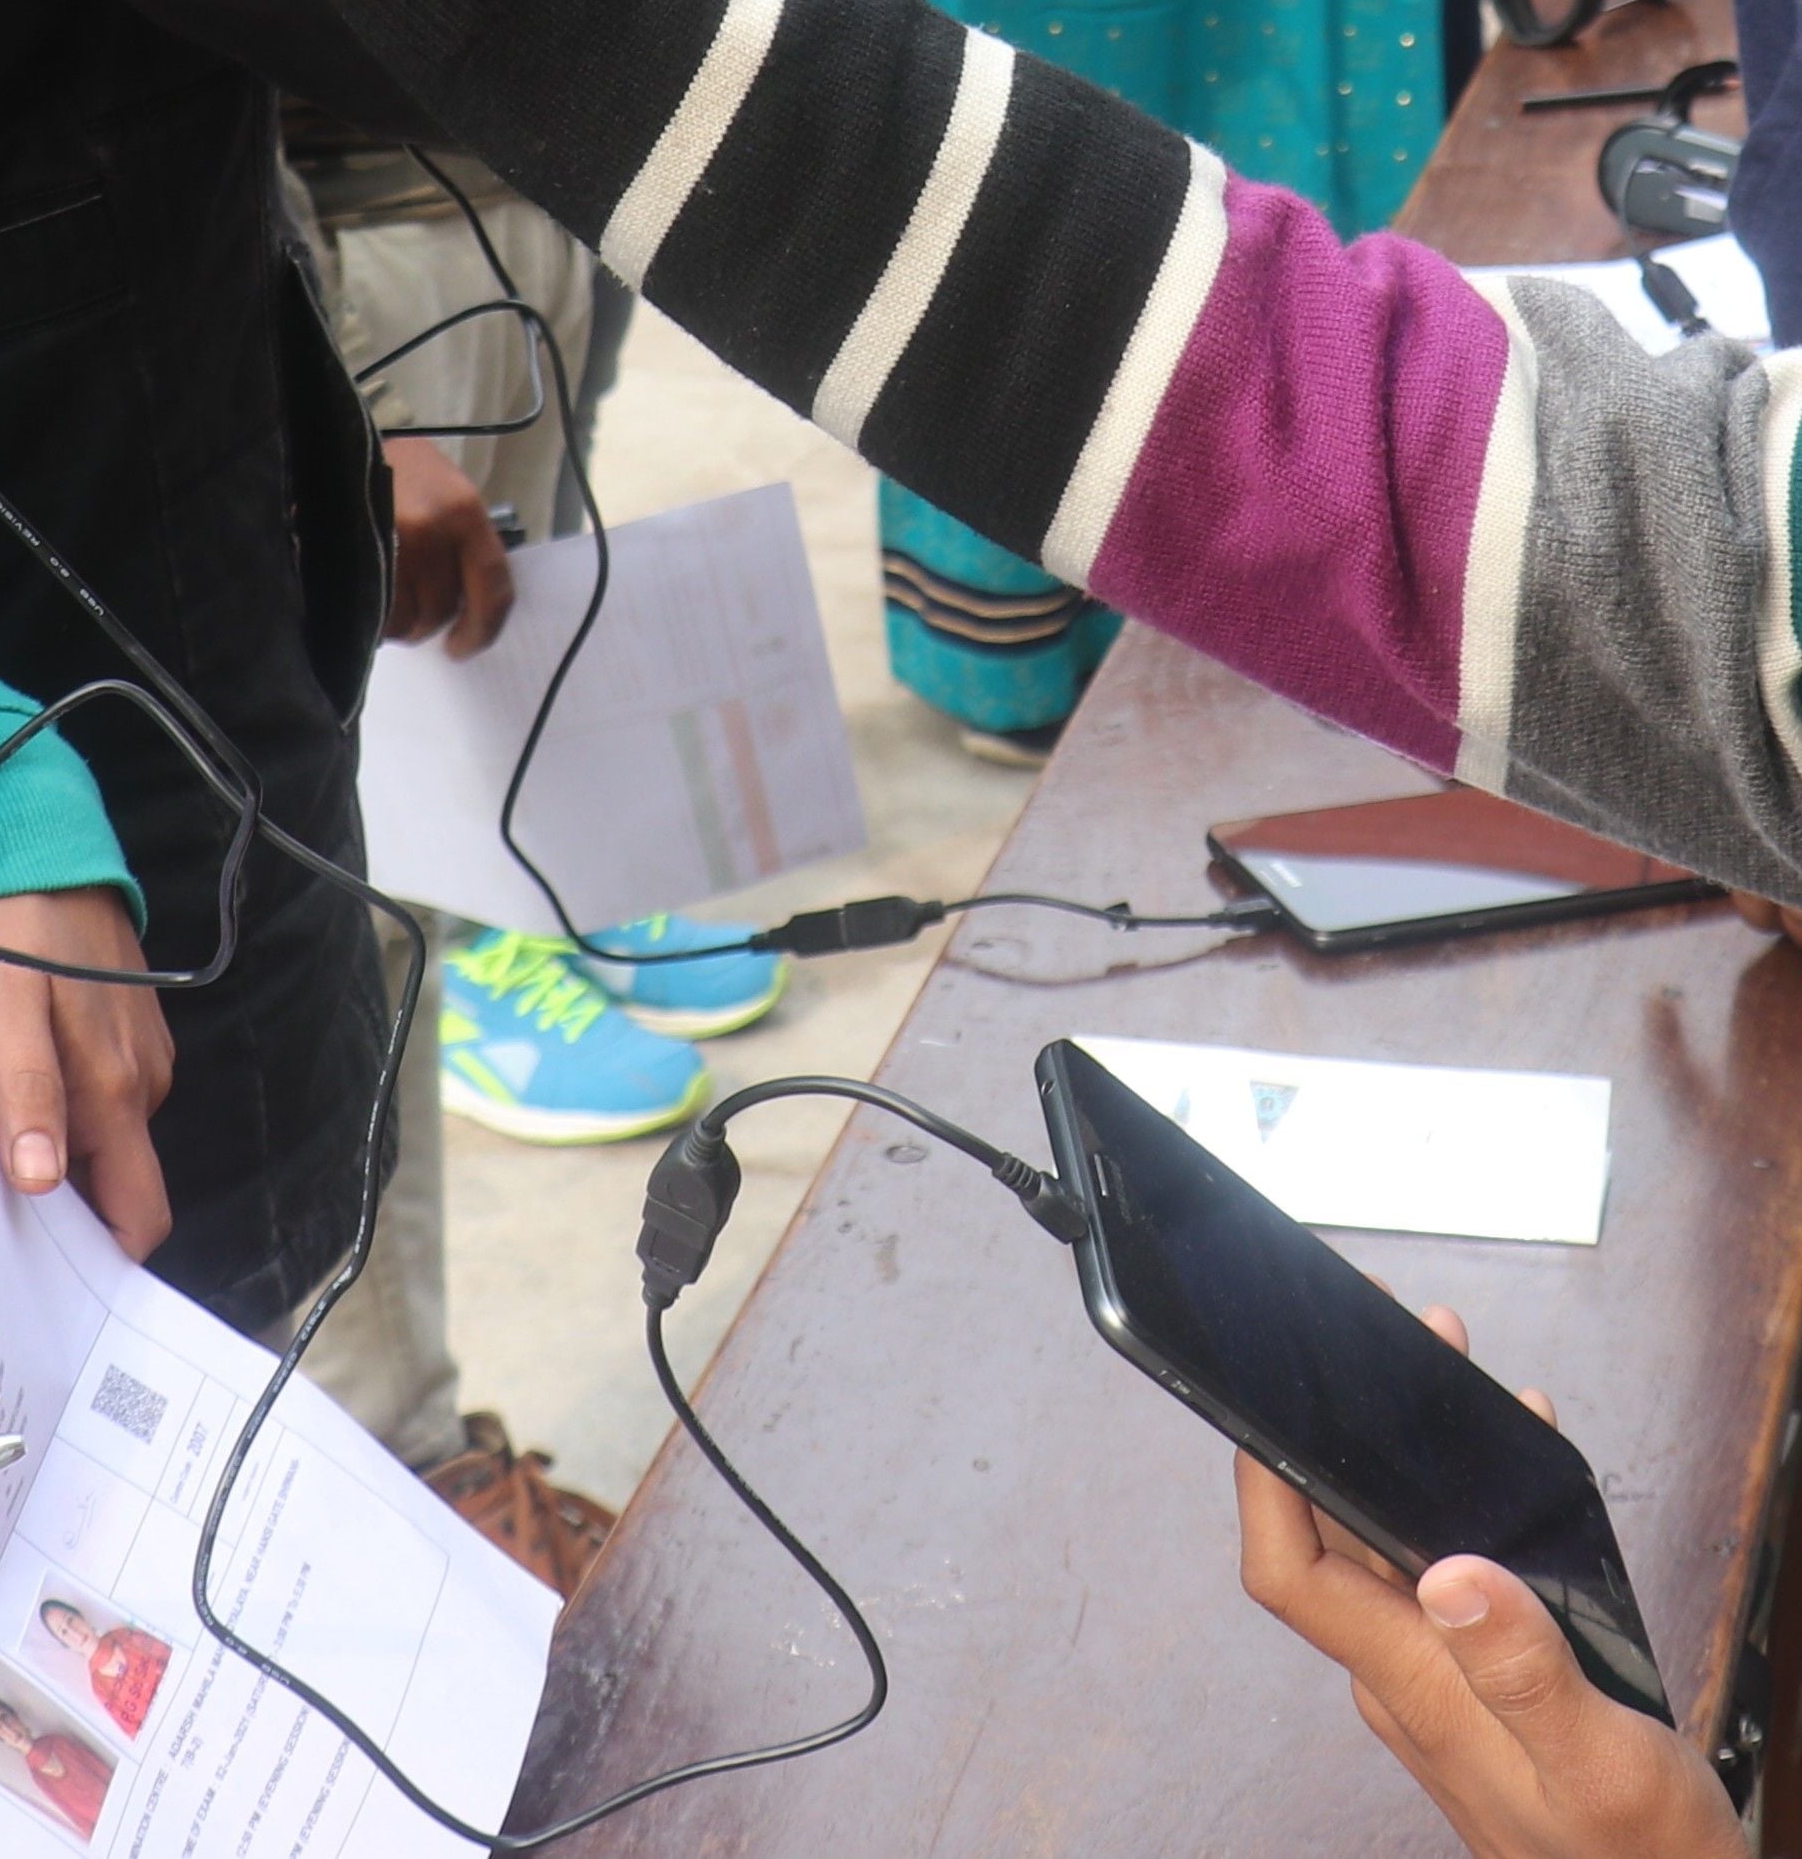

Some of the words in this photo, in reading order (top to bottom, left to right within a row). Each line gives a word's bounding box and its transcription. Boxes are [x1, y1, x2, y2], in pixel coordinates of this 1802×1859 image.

[299, 1300, 327, 1341] CABLE
[185, 1420, 209, 1458] 2007
[168, 1709, 196, 1759] ADARSH
